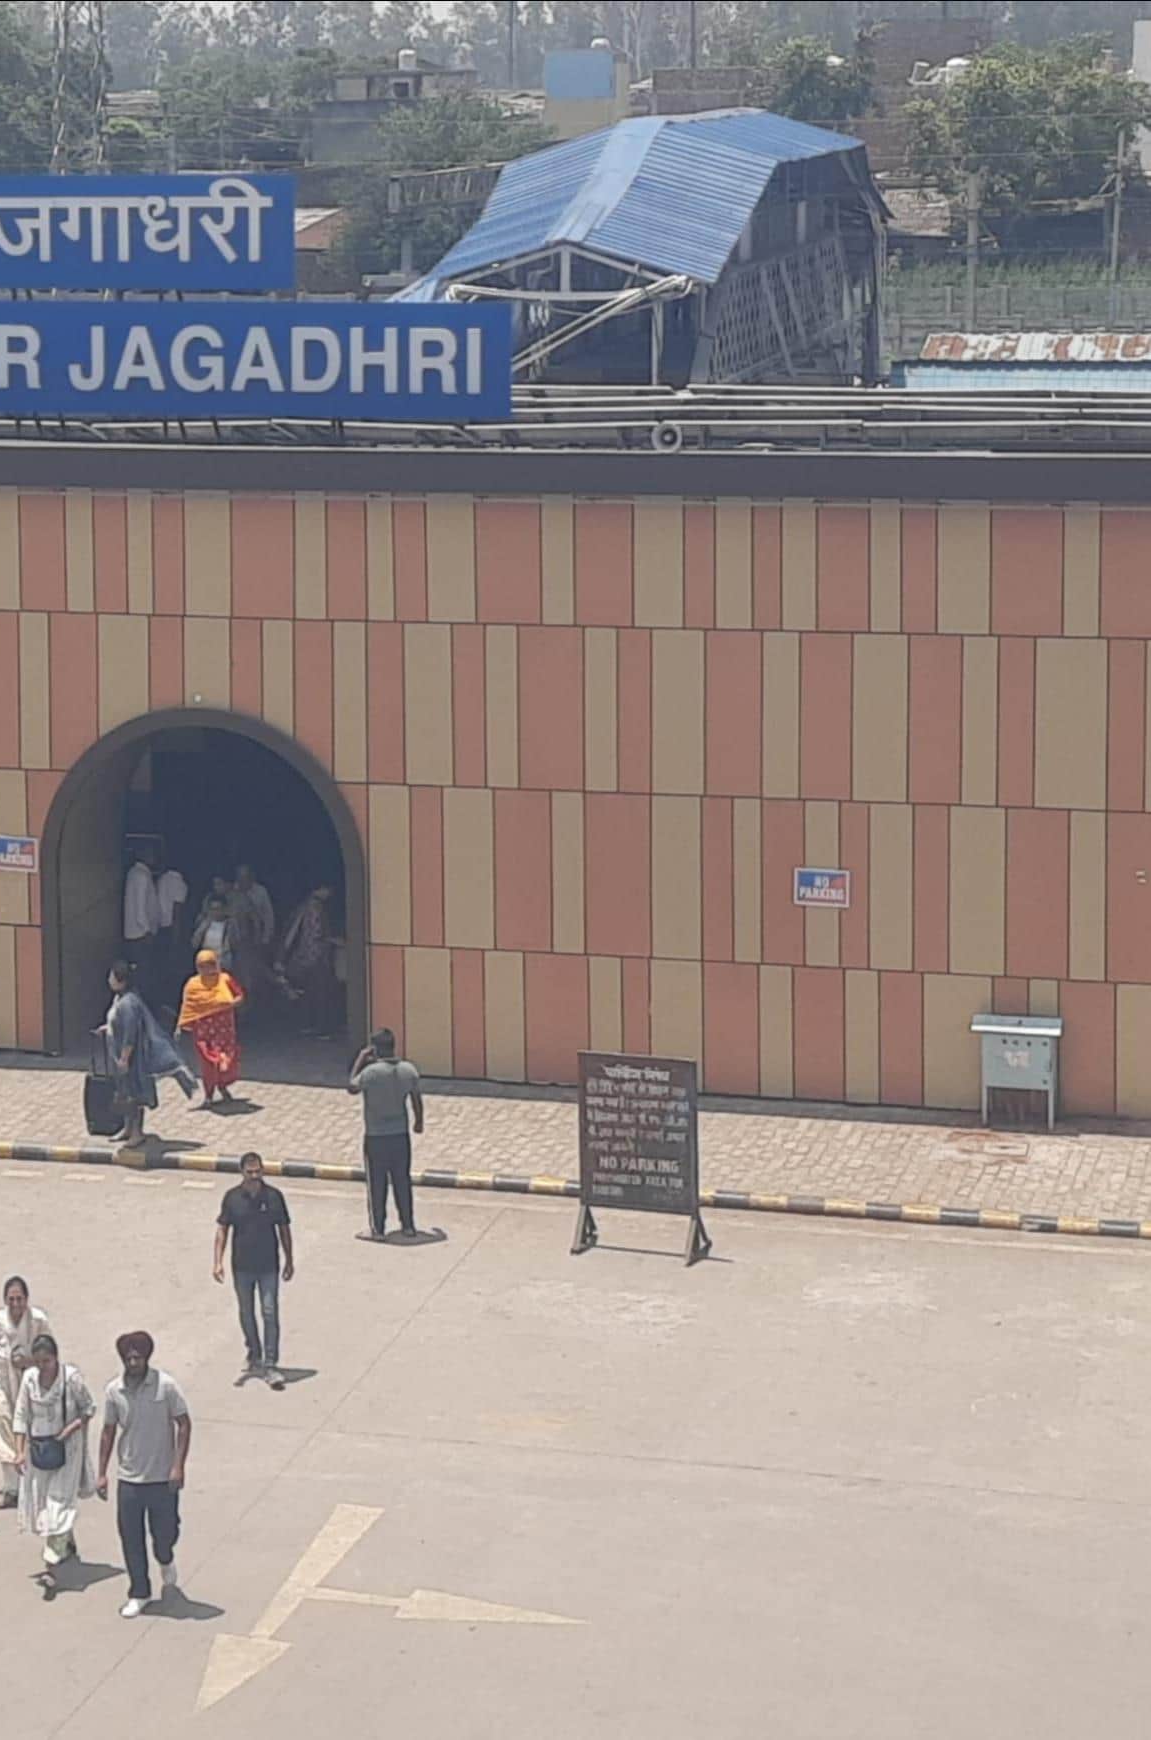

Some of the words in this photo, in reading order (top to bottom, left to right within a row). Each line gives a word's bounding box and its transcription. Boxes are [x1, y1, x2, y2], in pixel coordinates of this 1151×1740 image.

[68, 323, 482, 394] JAGADHRI
[799, 887, 846, 900] PARKING
[620, 1157, 680, 1174] PARKING
